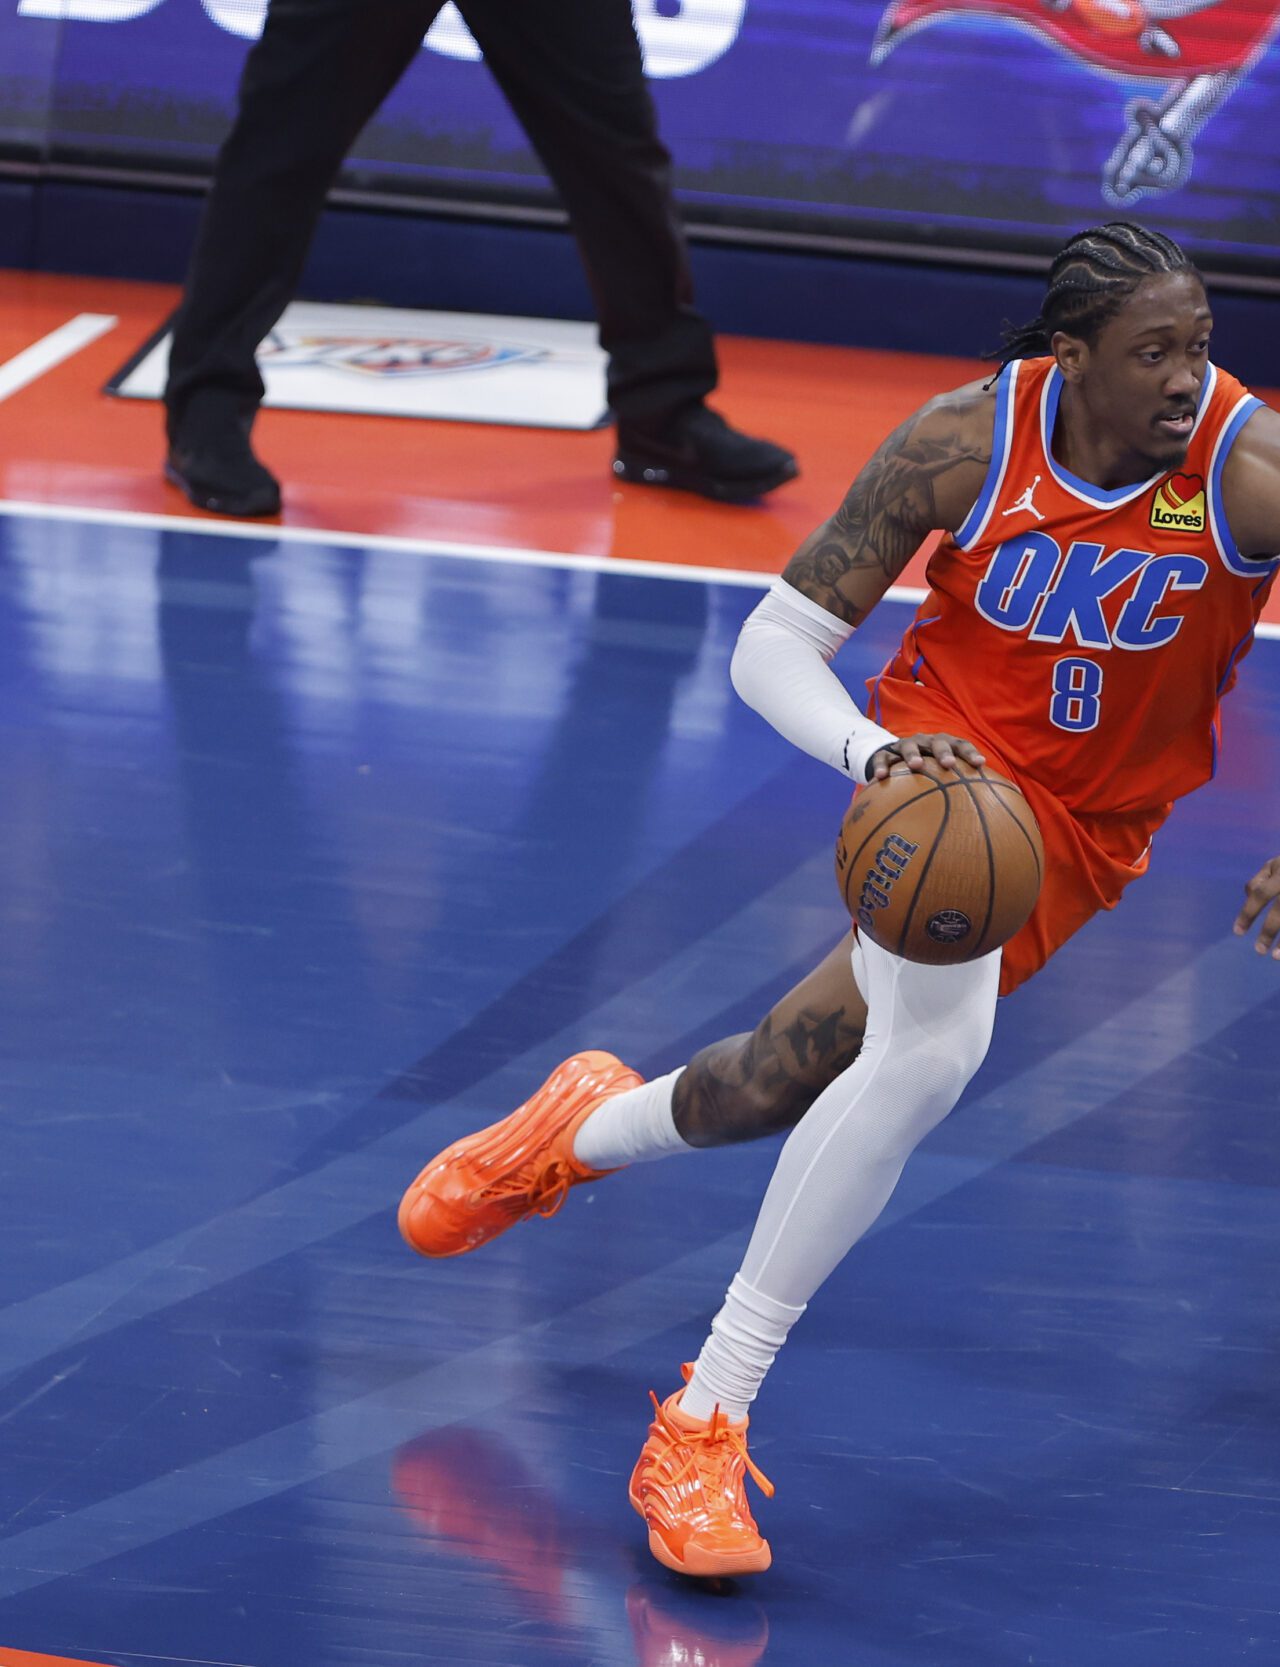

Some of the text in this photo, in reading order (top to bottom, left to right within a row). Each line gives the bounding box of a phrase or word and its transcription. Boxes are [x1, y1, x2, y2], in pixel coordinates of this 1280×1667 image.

[974, 530, 1209, 651] OKC
[1050, 657, 1103, 733] 8
[857, 833, 921, 937] Wilso
